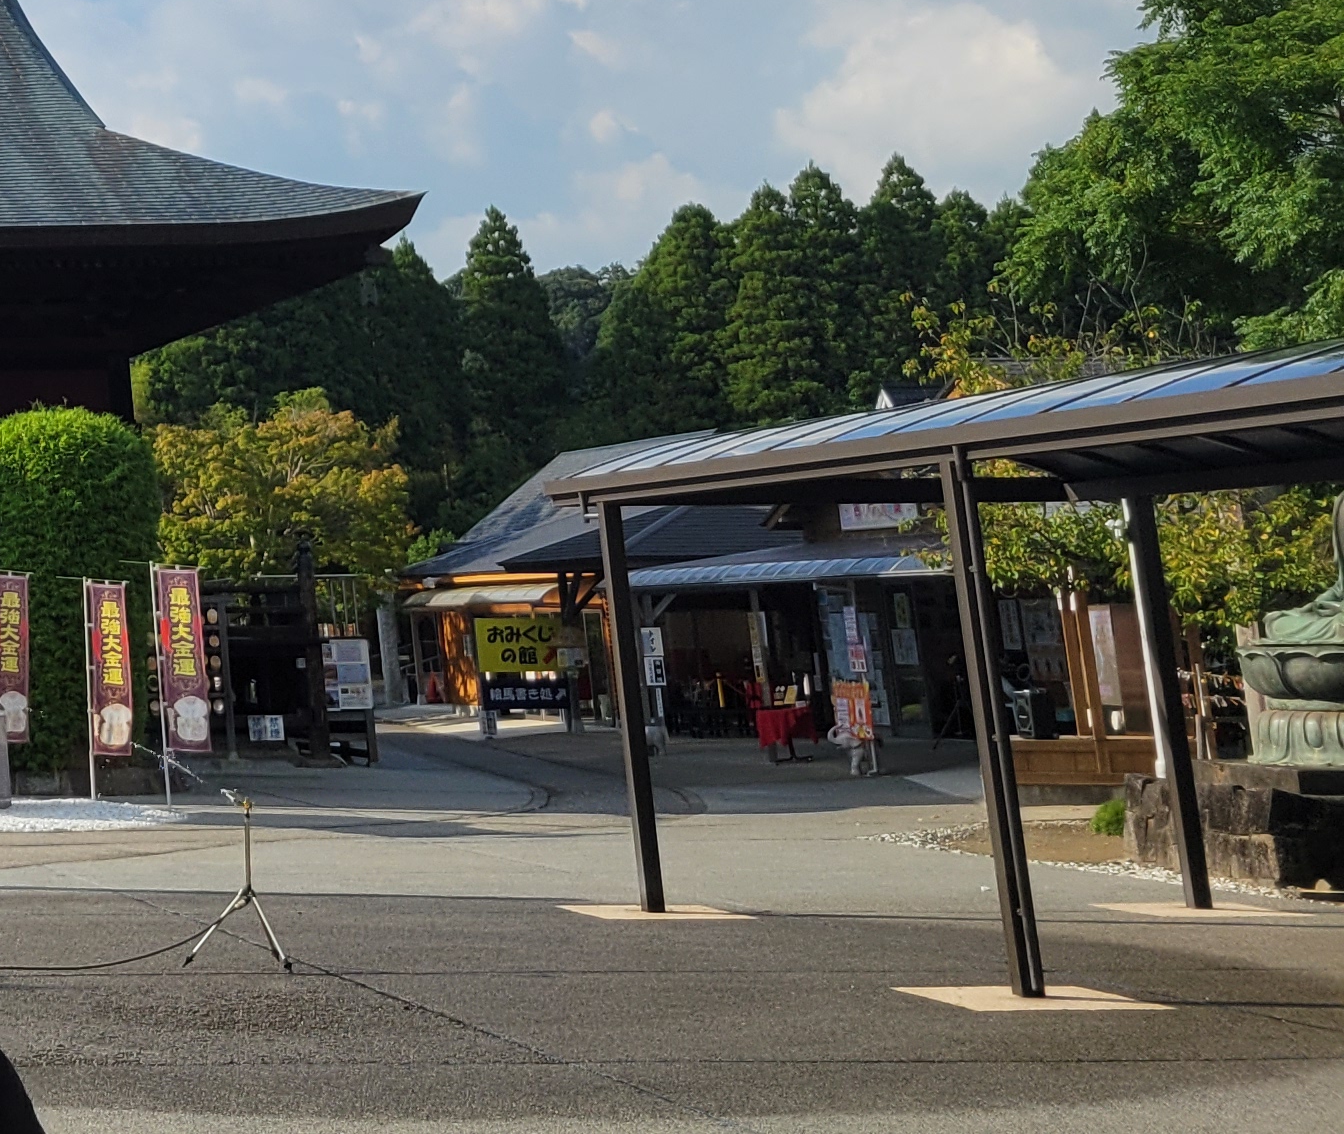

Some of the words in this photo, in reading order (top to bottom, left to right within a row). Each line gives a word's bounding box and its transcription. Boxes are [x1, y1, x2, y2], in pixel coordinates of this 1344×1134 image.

[0, 591, 21, 674] 最強大金運
[101, 601, 124, 686] 最強大金運
[169, 587, 196, 677] 最強大金運
[487, 626, 553, 643] おみくじ
[501, 646, 538, 665] の館
[490, 687, 553, 701] 絵馬書き処
